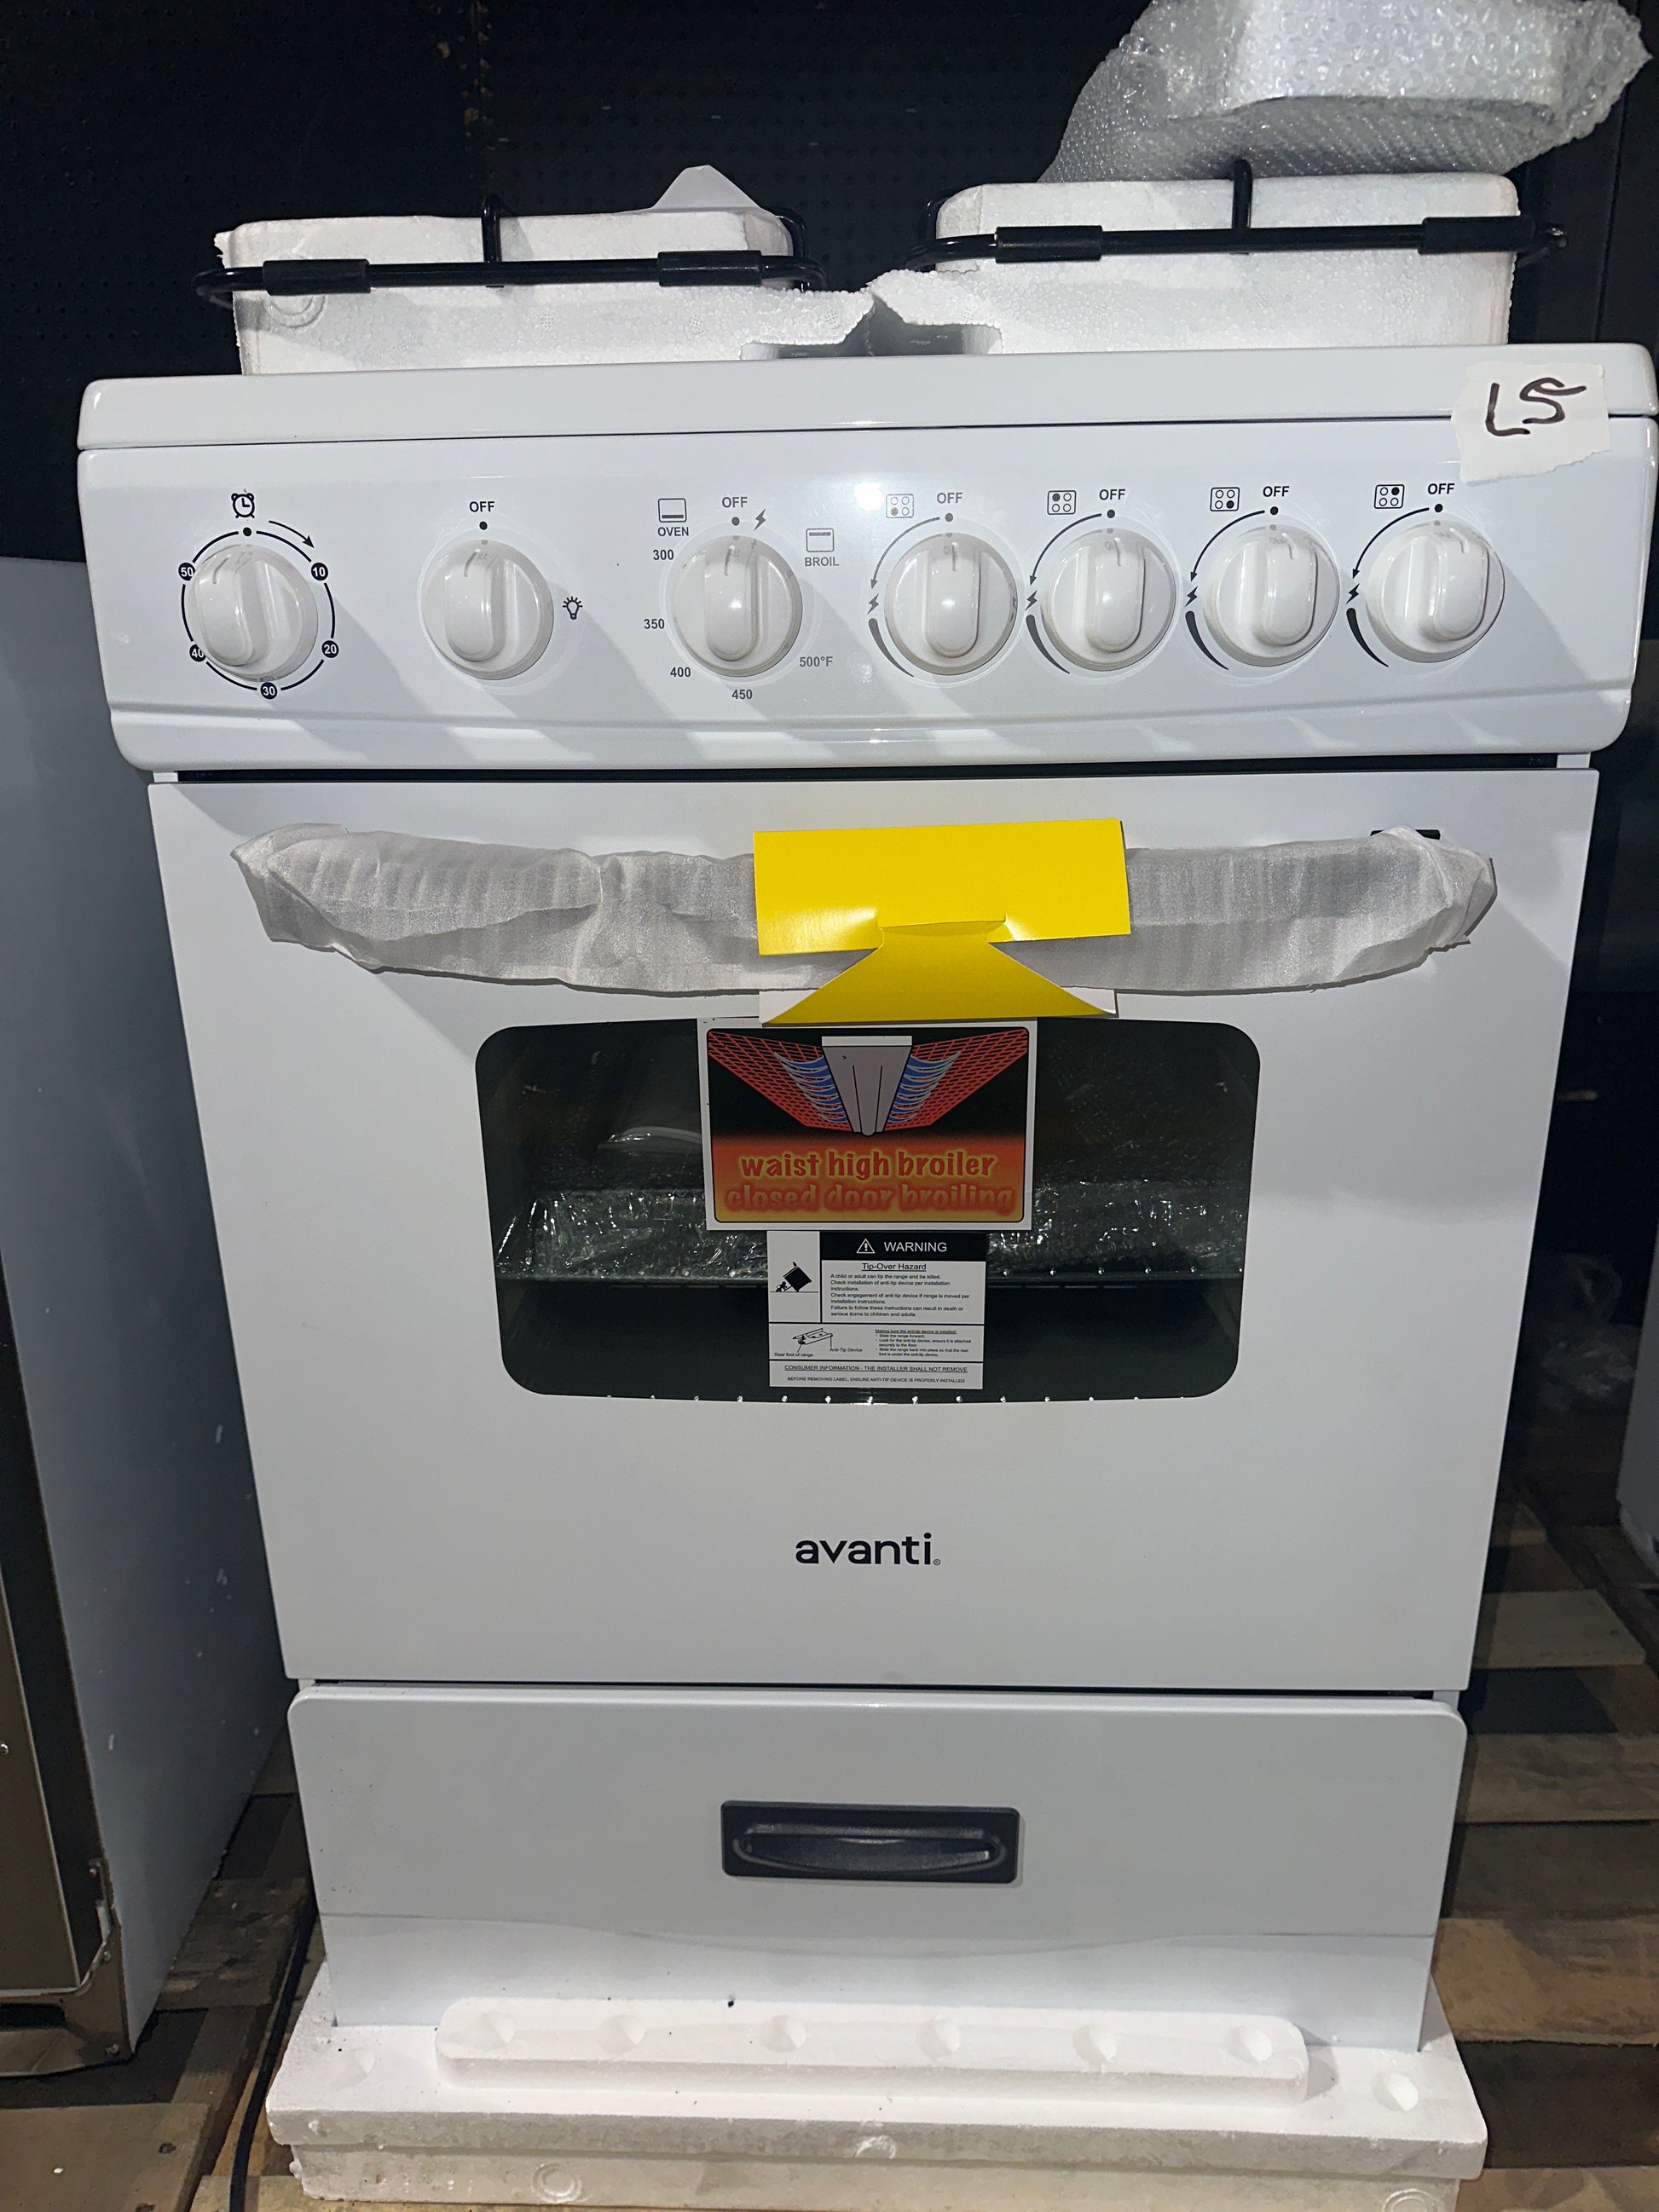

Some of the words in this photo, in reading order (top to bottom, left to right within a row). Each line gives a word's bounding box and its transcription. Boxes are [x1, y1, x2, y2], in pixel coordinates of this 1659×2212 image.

[1099, 488, 1126, 500] OFF
[1263, 486, 1290, 498] OFF
[1427, 483, 1455, 495] OFF
[721, 497, 749, 509] OFF
[936, 492, 963, 505] OFF
[469, 500, 495, 513] OFF
[657, 527, 689, 537] OVEN
[653, 550, 674, 561] 300
[804, 557, 839, 567] BROIL
[180, 566, 194, 578] 50
[312, 567, 327, 578] 10
[644, 618, 665, 629] 350
[324, 644, 338, 656] 20
[670, 667, 691, 678] 400
[262, 685, 277, 696] 30
[731, 689, 753, 700] 450
[741, 1152, 820, 1176] waist
[828, 1151, 889, 1181] high
[898, 1151, 996, 1177] broiler
[725, 1183, 818, 1211] closed
[824, 1183, 895, 1211] door
[899, 1183, 1016, 1216] broiling
[884, 1242, 947, 1252] WARNING
[862, 1262, 896, 1271] Tip-Over
[898, 1263, 927, 1272] Hazard
[795, 1532, 932, 1565] avanti
